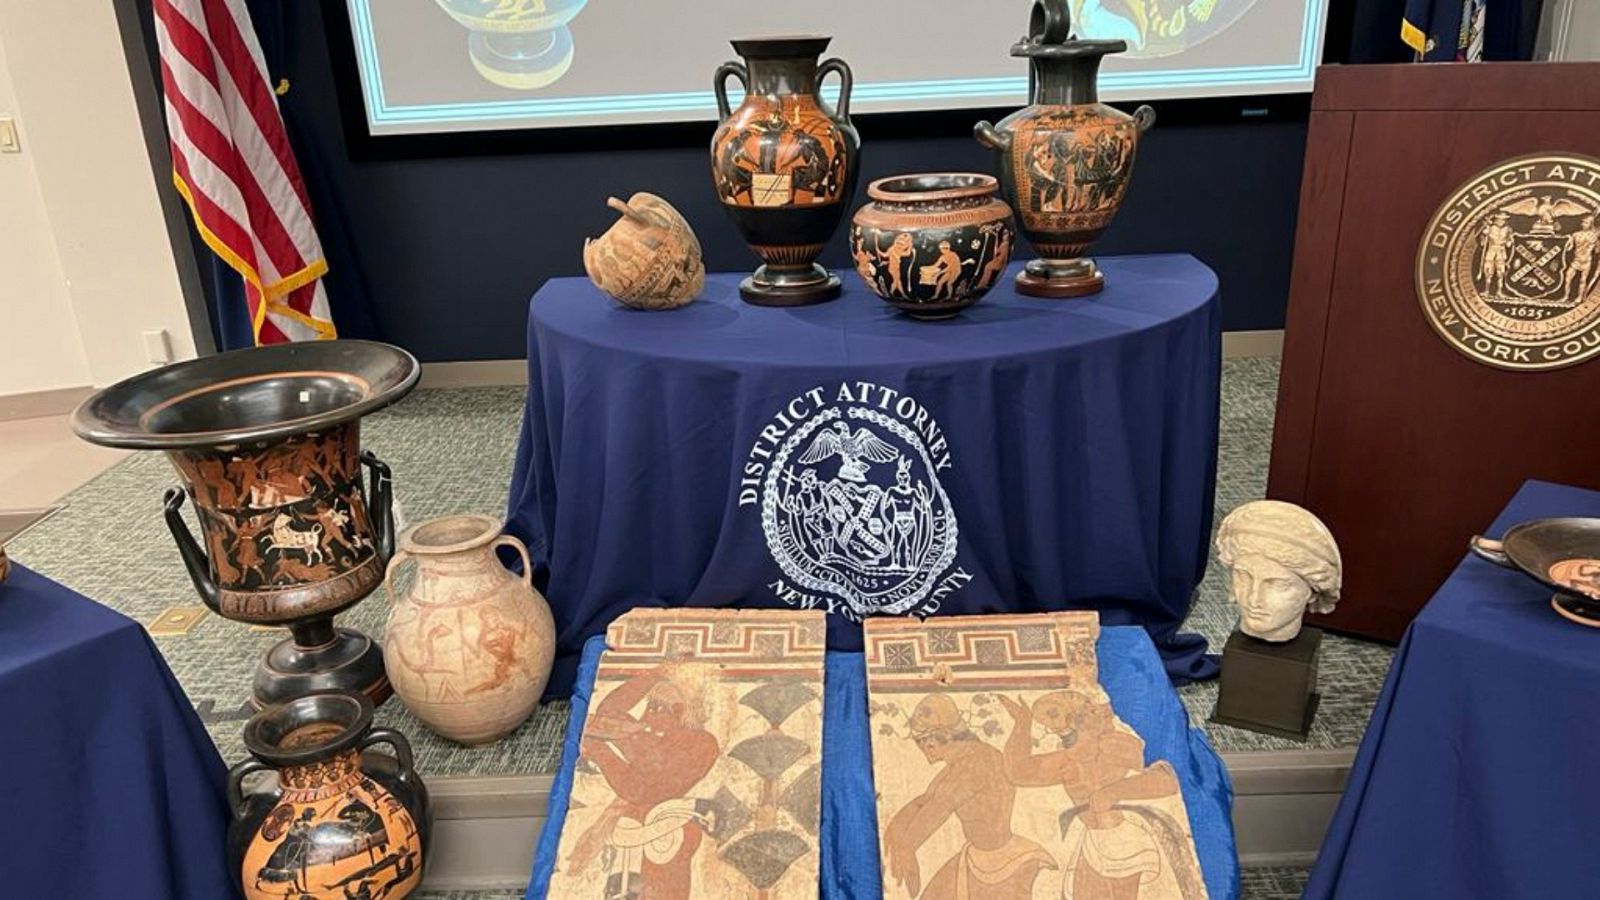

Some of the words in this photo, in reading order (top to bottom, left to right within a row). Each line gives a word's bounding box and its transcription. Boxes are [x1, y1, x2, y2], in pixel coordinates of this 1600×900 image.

[1432, 166, 1535, 248] DISTRICT
[1427, 279, 1459, 326] NEW
[1462, 327, 1530, 361] YORK
[1543, 330, 1600, 360] COU
[1510, 306, 1544, 319] 1625
[739, 386, 825, 506] DISTRICT
[836, 381, 952, 473] ATTORNEY
[767, 579, 822, 611] NEW
[851, 572, 878, 589] 1625
[887, 577, 924, 602] NOVI
